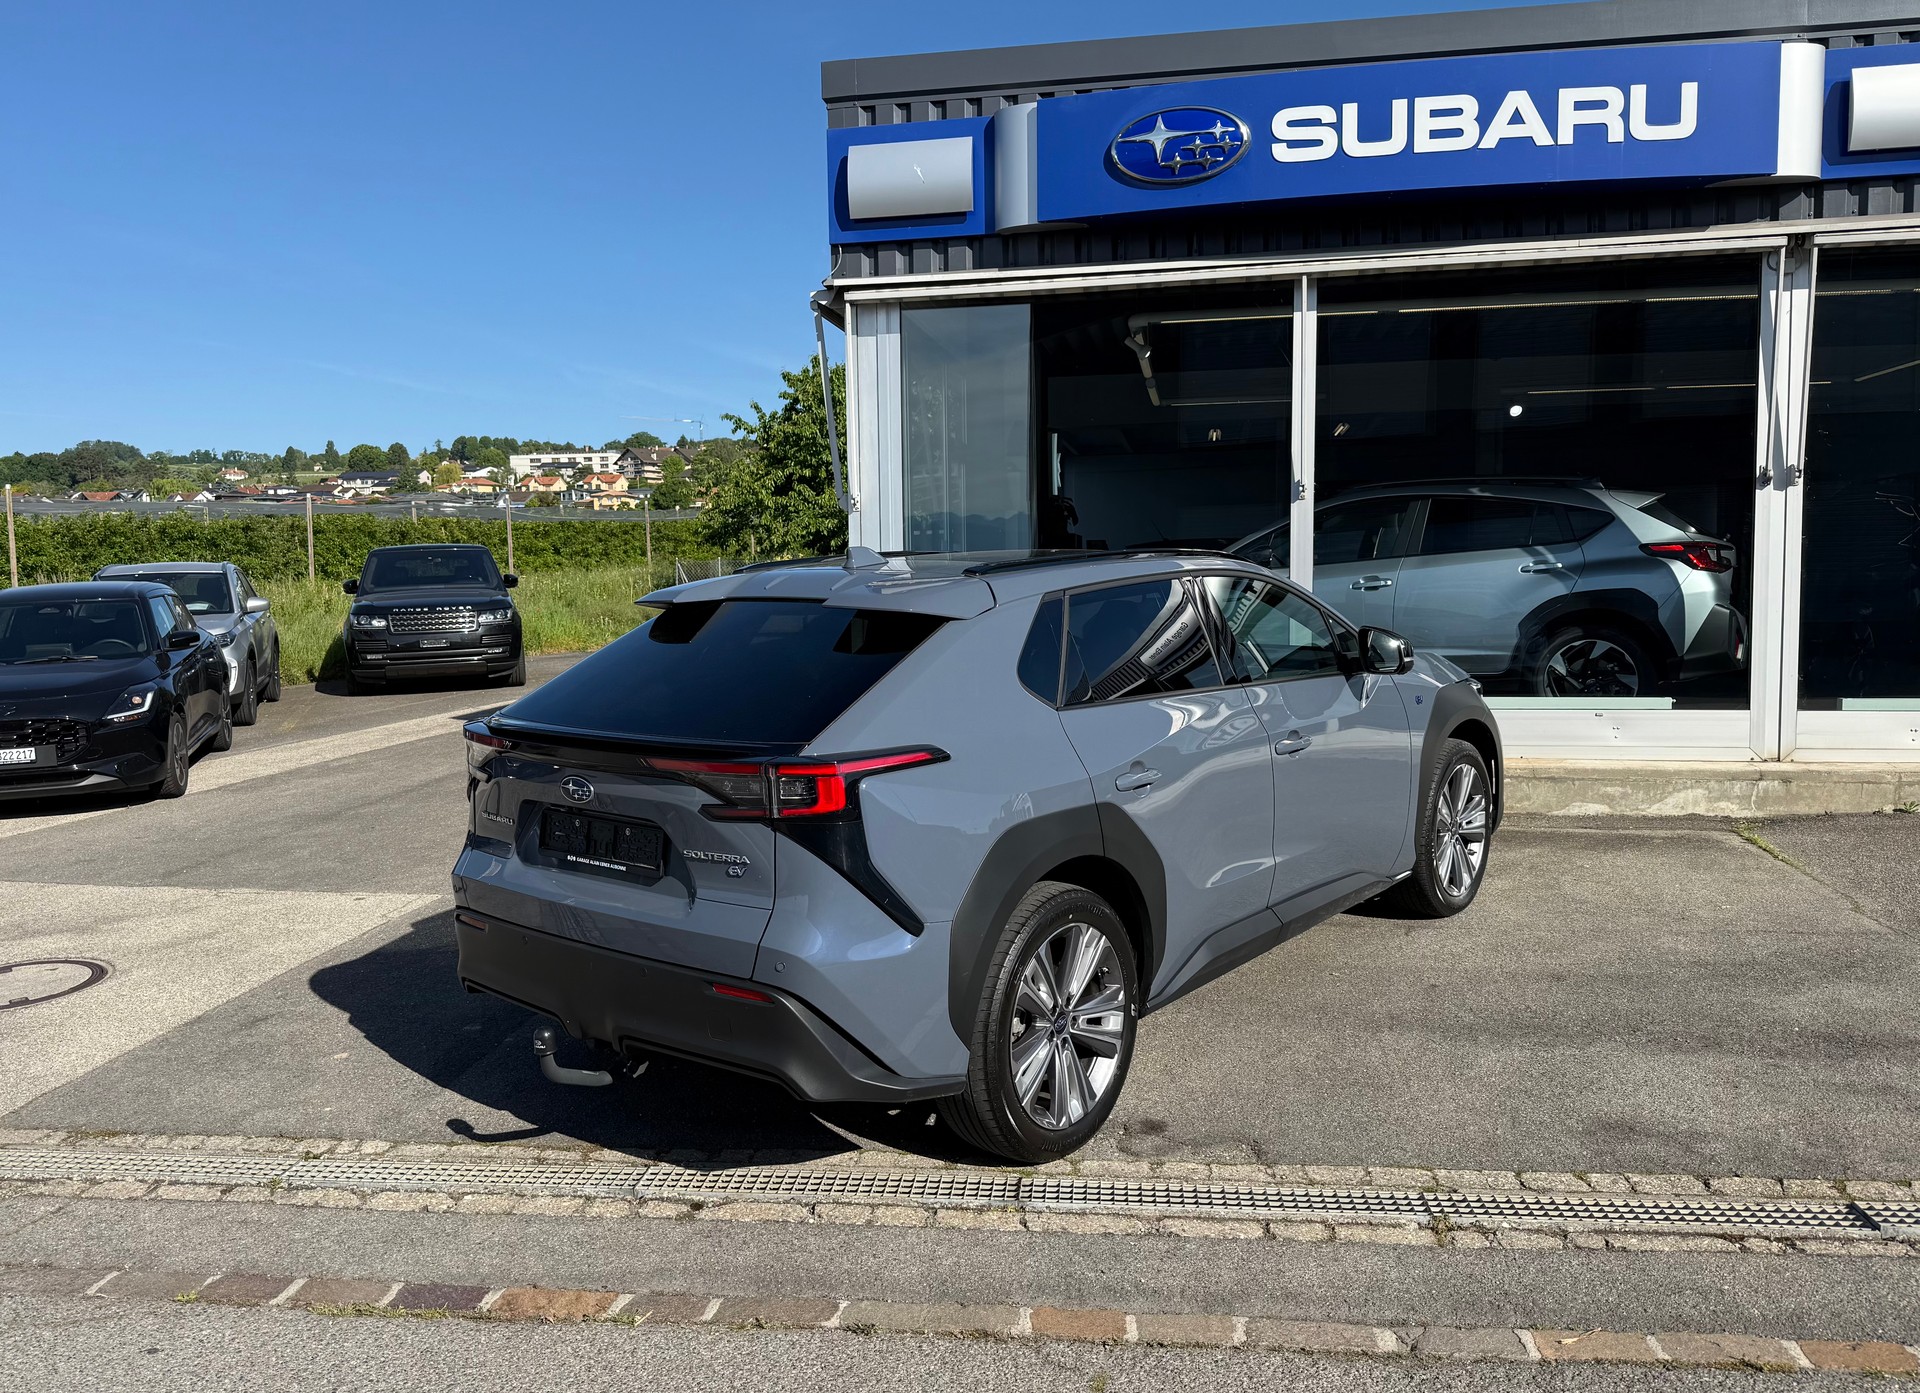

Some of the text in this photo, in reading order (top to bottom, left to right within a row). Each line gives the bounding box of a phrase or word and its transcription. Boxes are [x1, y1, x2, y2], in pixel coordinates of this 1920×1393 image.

[1271, 82, 1698, 163] SUBARU
[15, 749, 33, 760] 217
[481, 811, 513, 826] SUBARU
[683, 849, 751, 864] SOLTERRA
[728, 865, 748, 876] EV
